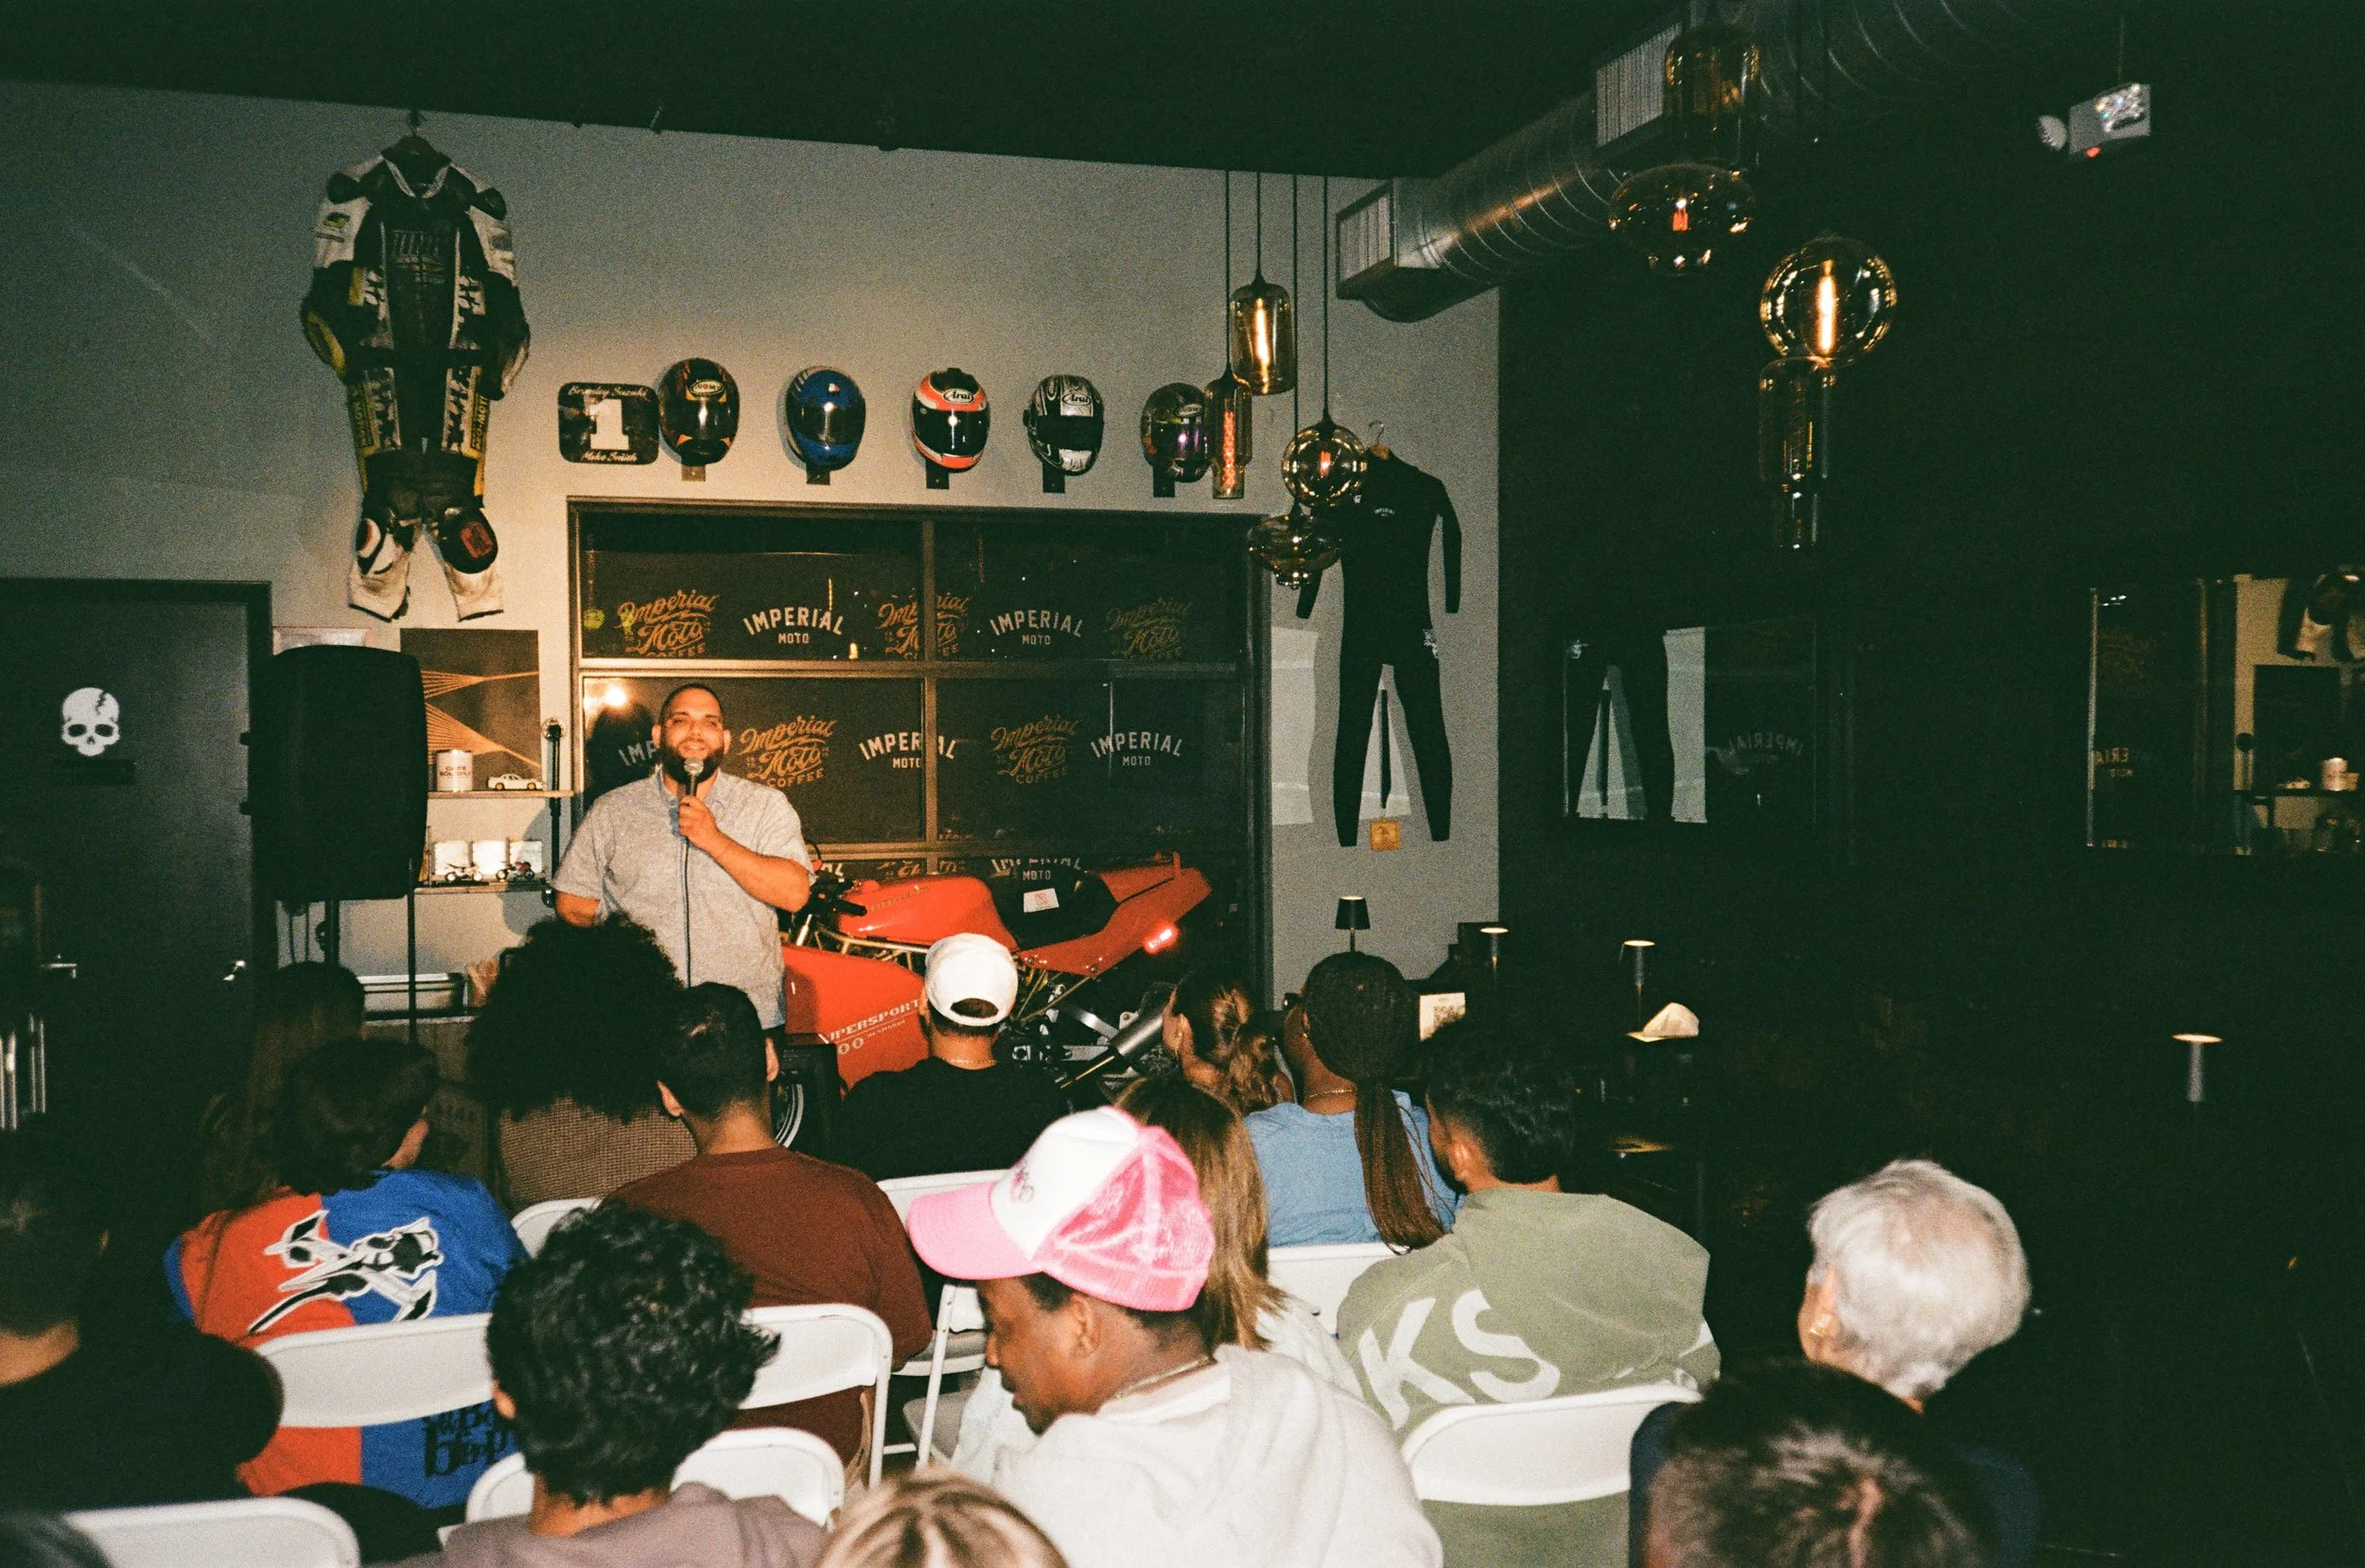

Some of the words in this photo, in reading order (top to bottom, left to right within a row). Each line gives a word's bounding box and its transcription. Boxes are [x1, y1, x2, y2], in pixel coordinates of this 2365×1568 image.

[586, 398, 630, 450] 1
[614, 589, 721, 628] Imperial
[743, 606, 844, 636] IMPERIAL
[990, 610, 1083, 637] IMPERIAL
[778, 633, 810, 644] MOTO
[1022, 635, 1051, 645] MOTO
[738, 715, 838, 756] Imperial
[989, 714, 1081, 752] Imperial
[1090, 731, 1182, 758] IMPERIAL
[1122, 756, 1151, 766] MOTO
[767, 768, 825, 788] COFFEE
[1015, 767, 1068, 784] COFFEE
[1023, 870, 1051, 880] MOTO
[837, 1037, 865, 1055] 00
